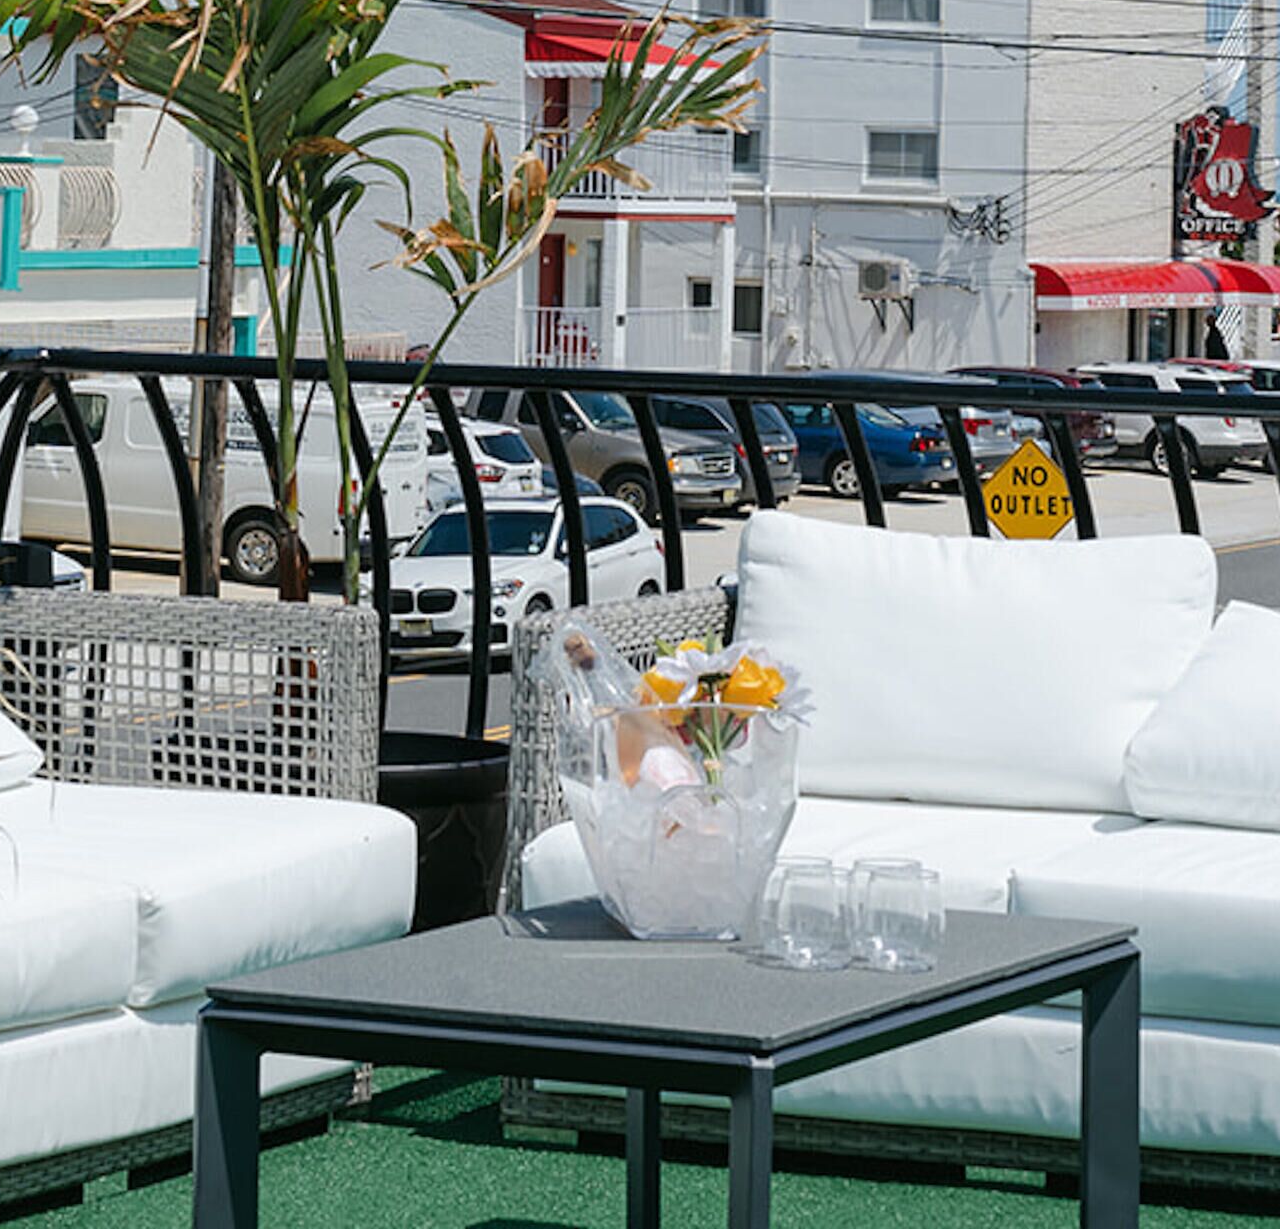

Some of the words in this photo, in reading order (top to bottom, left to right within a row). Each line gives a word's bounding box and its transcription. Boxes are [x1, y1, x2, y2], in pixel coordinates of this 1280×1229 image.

[1181, 218, 1245, 233] OFFICE
[1012, 466, 1048, 487] NO
[991, 494, 1072, 517] OUTLET
